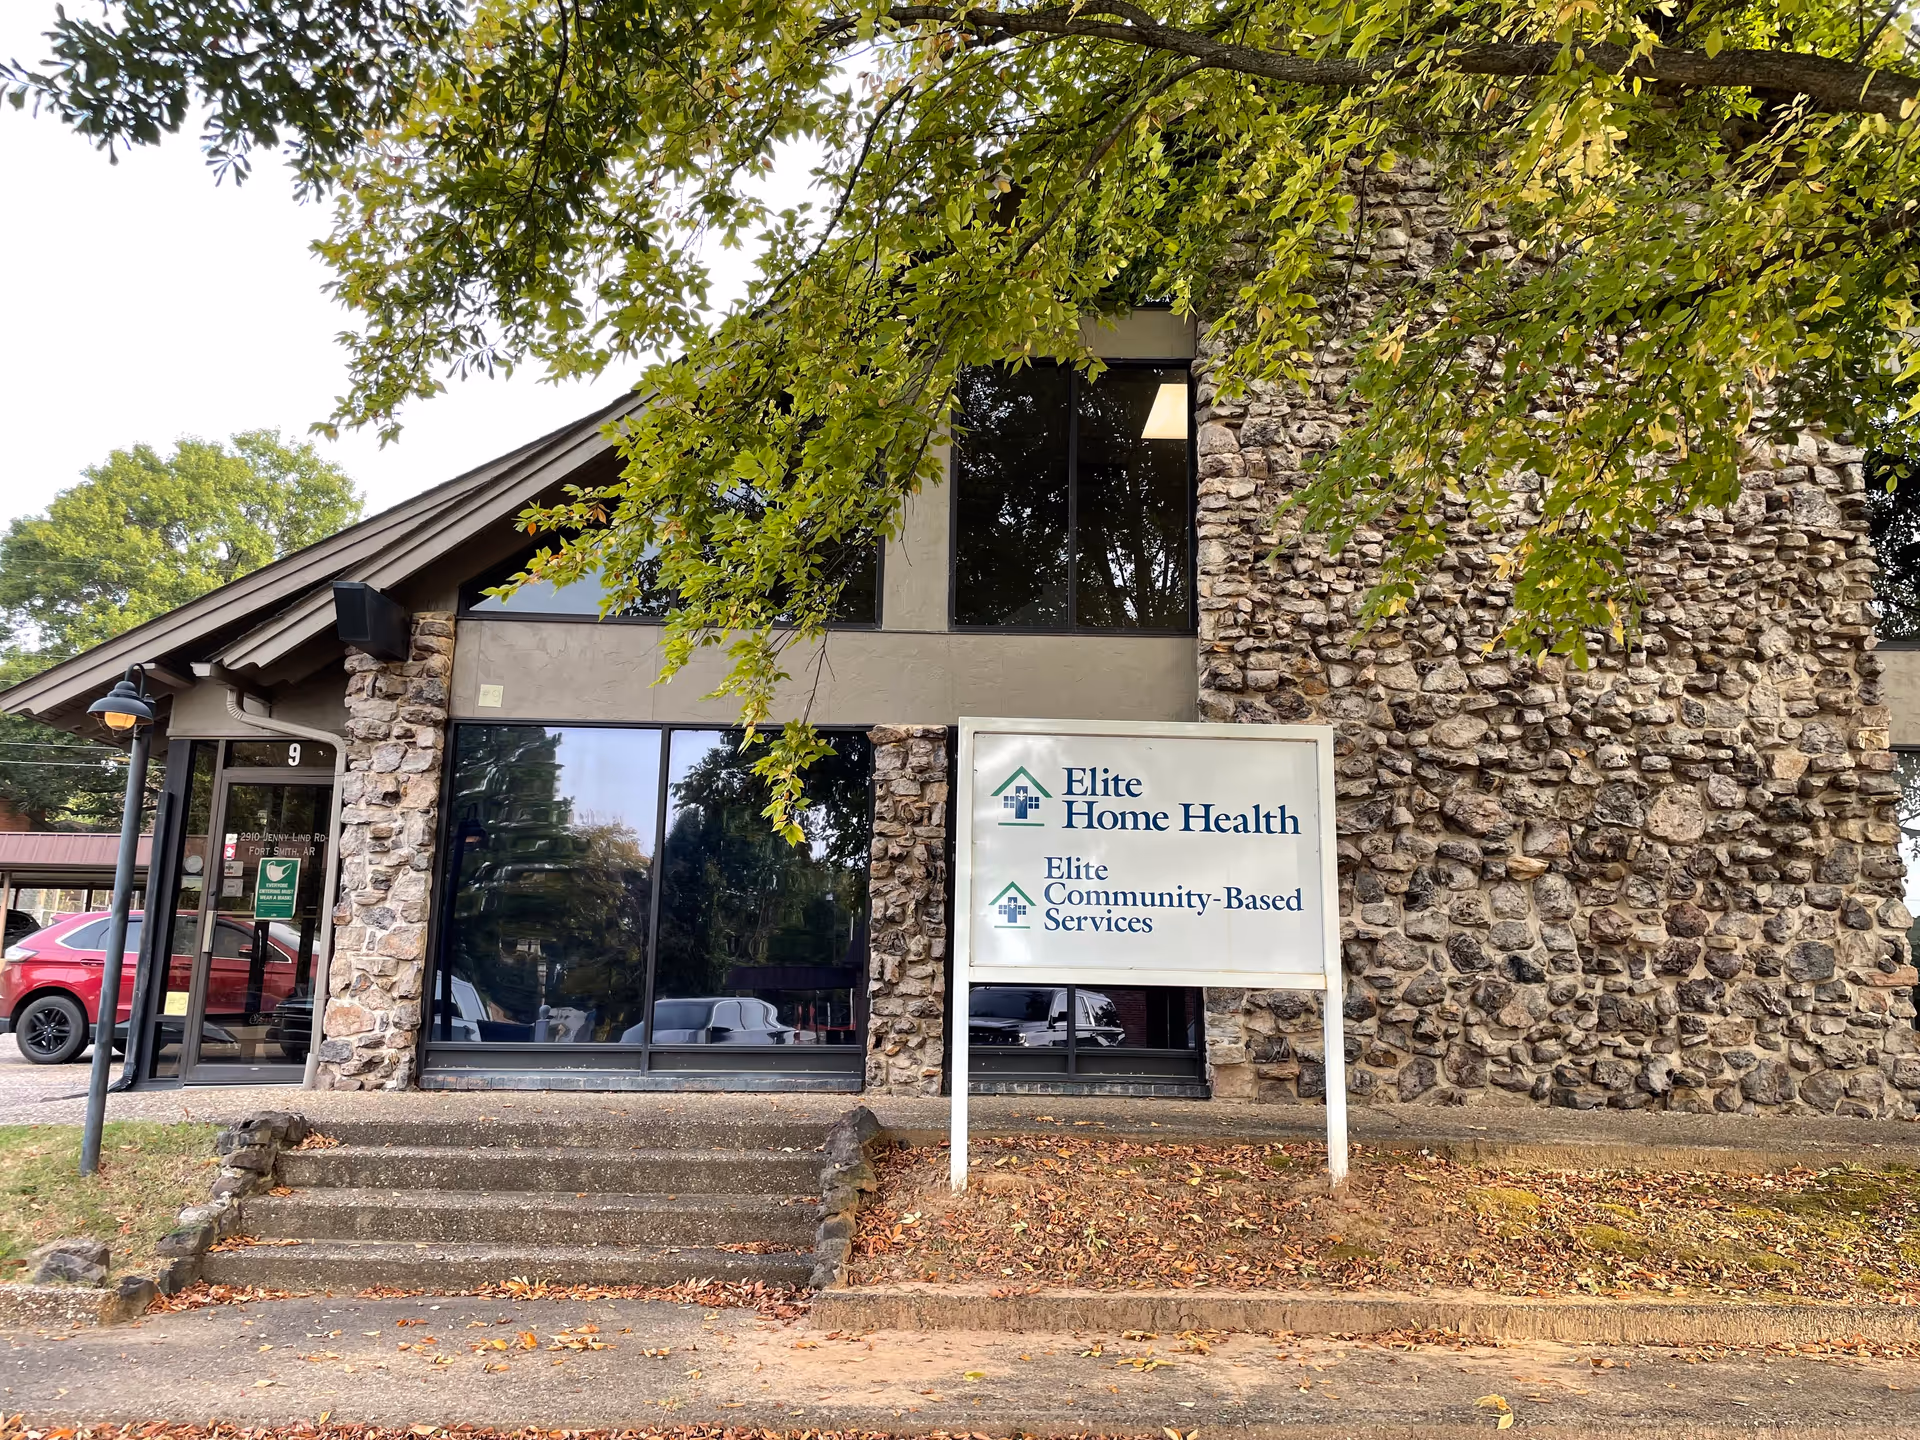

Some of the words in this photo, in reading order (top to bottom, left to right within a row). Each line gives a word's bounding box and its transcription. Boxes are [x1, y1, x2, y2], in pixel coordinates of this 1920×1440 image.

[288, 742, 302, 767] 9
[1061, 767, 1144, 798] Elite
[1061, 800, 1170, 832] Home
[1178, 803, 1302, 835] Health
[240, 832, 260, 842] 2910
[263, 833, 288, 842] JENNY
[292, 833, 311, 842] LIND
[249, 846, 270, 856] FORT
[303, 847, 316, 856] AR
[1043, 856, 1109, 881] Elite
[1043, 882, 1305, 917] Community-Based
[1043, 907, 1154, 934] Services
